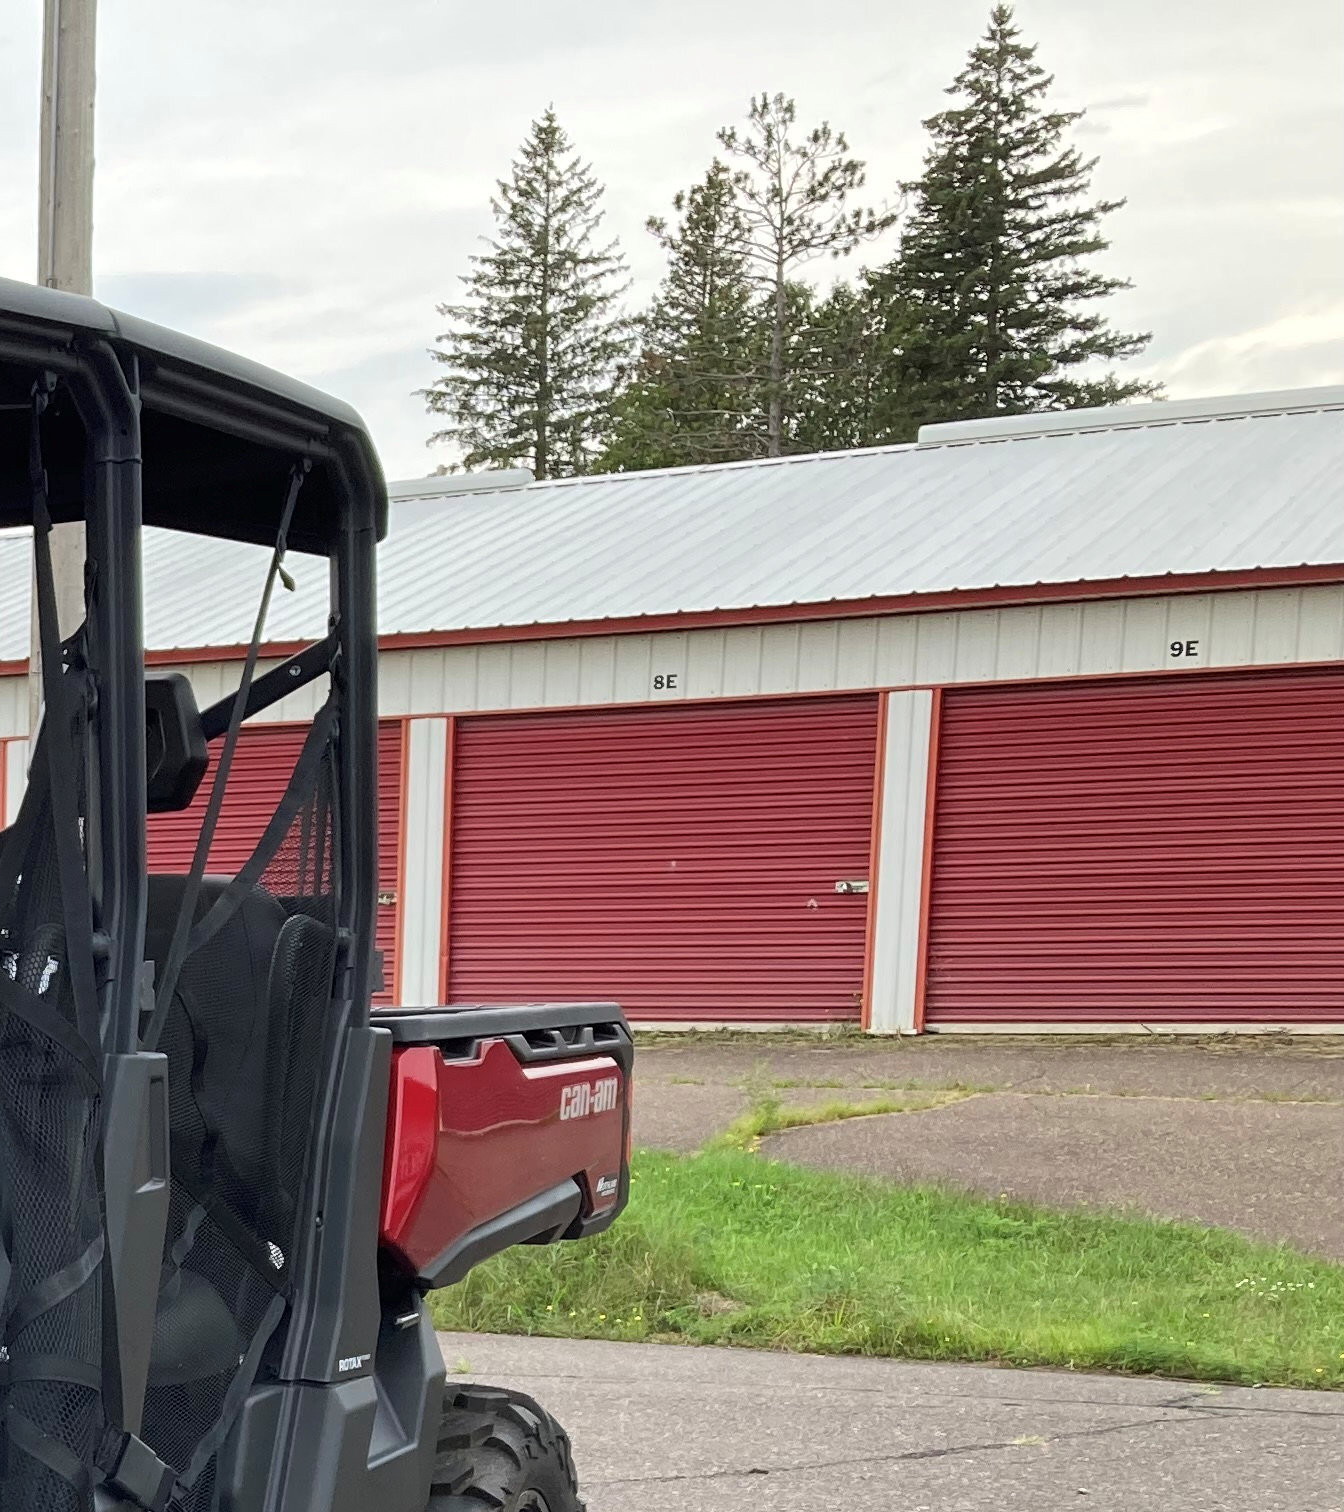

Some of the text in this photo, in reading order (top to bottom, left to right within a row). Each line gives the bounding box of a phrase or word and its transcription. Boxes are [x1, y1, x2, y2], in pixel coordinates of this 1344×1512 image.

[1169, 640, 1199, 657] 9E
[653, 674, 678, 689] 8E
[338, 1356, 362, 1372] ROTAX
